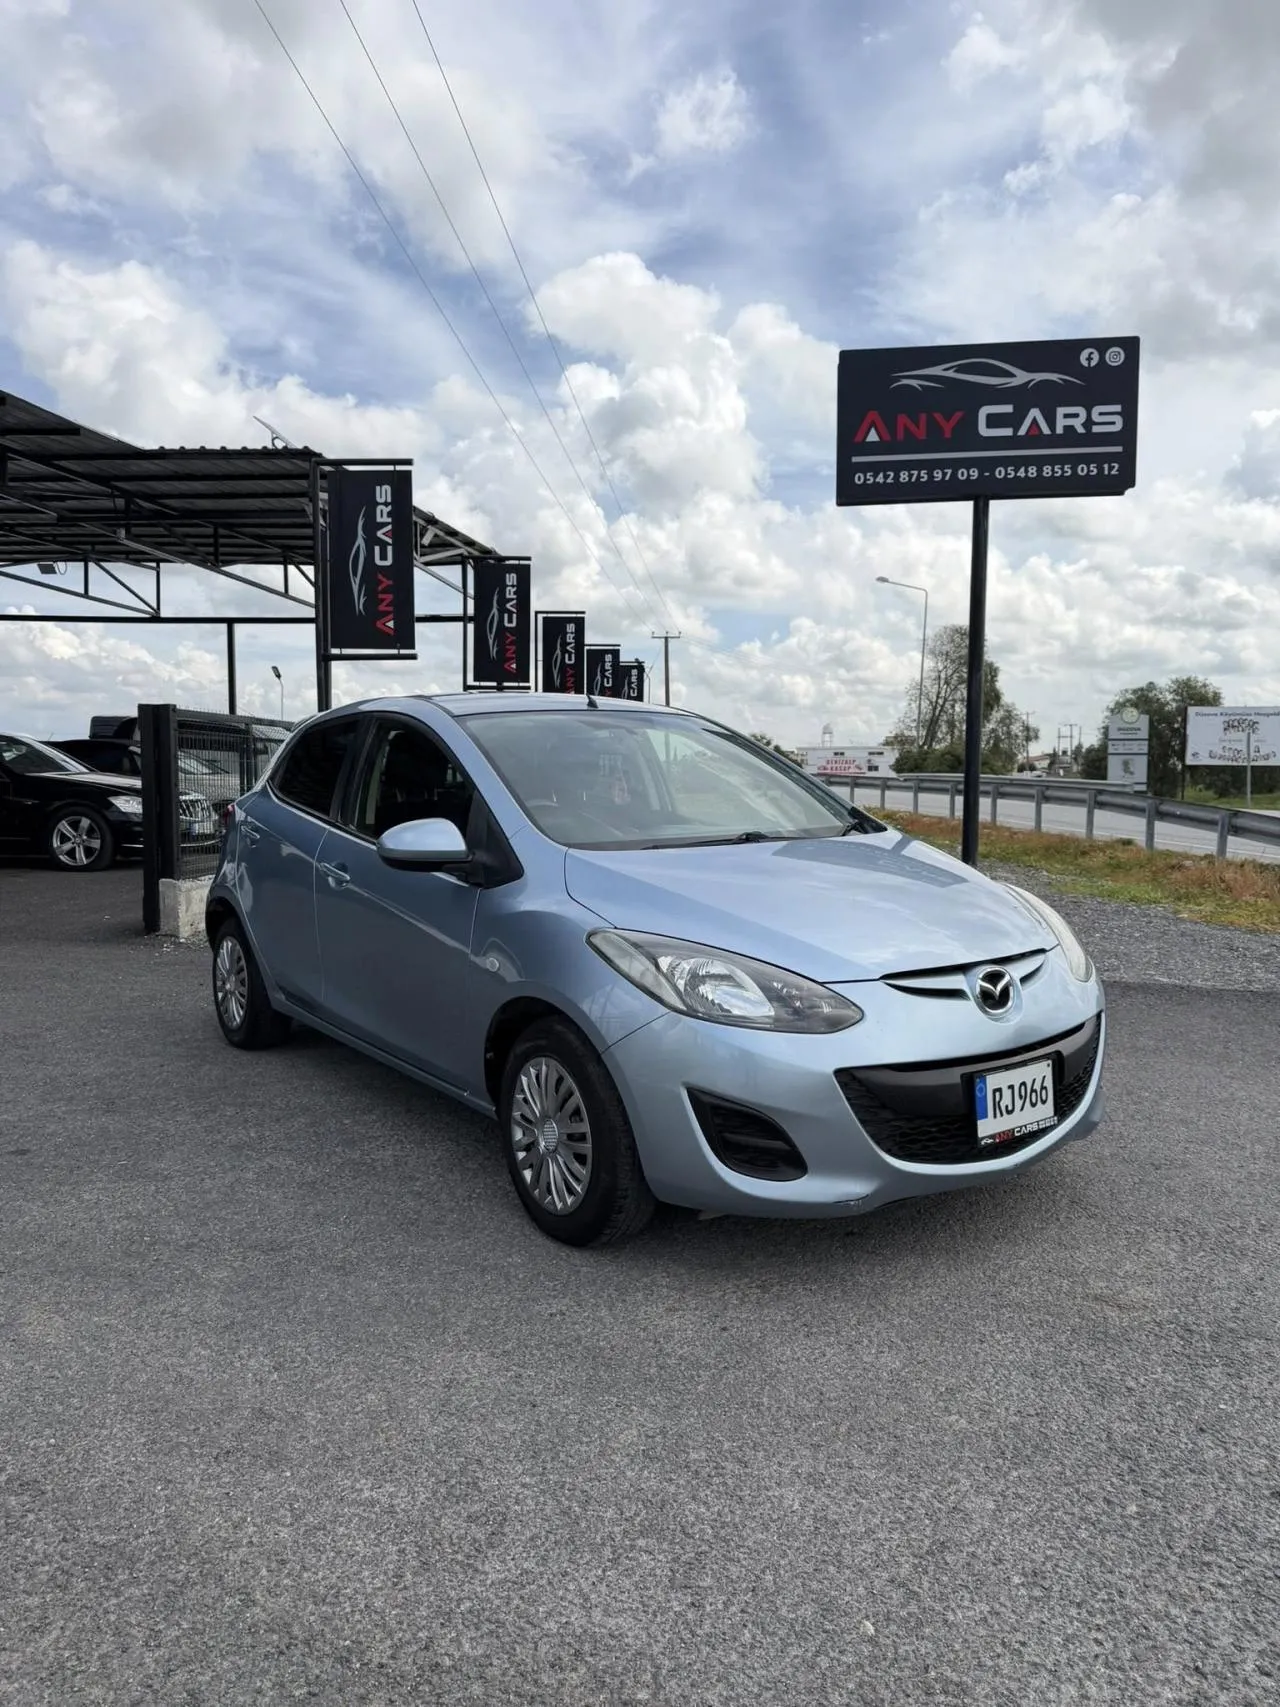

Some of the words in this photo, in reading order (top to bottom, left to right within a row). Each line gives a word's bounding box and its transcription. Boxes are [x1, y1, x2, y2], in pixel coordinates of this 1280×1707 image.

[854, 410, 965, 443] ANY
[978, 404, 1123, 437] CARS
[855, 471, 894, 484] 0542
[900, 470, 928, 482] 875
[933, 469, 952, 481] 97
[958, 468, 979, 480] 09
[995, 466, 1037, 479] 0548
[1042, 465, 1072, 477] 855
[1077, 464, 1097, 476] 05
[1103, 463, 1120, 475] 12
[374, 484, 393, 566] CARS
[375, 573, 394, 635] ANY
[504, 573, 517, 627] CARS
[504, 632, 517, 673] ANY
[565, 623, 575, 664] CARS
[604, 654, 613, 687] CARS
[630, 669, 638, 696] CARS
[1014, 1121, 1039, 1136] CARS
